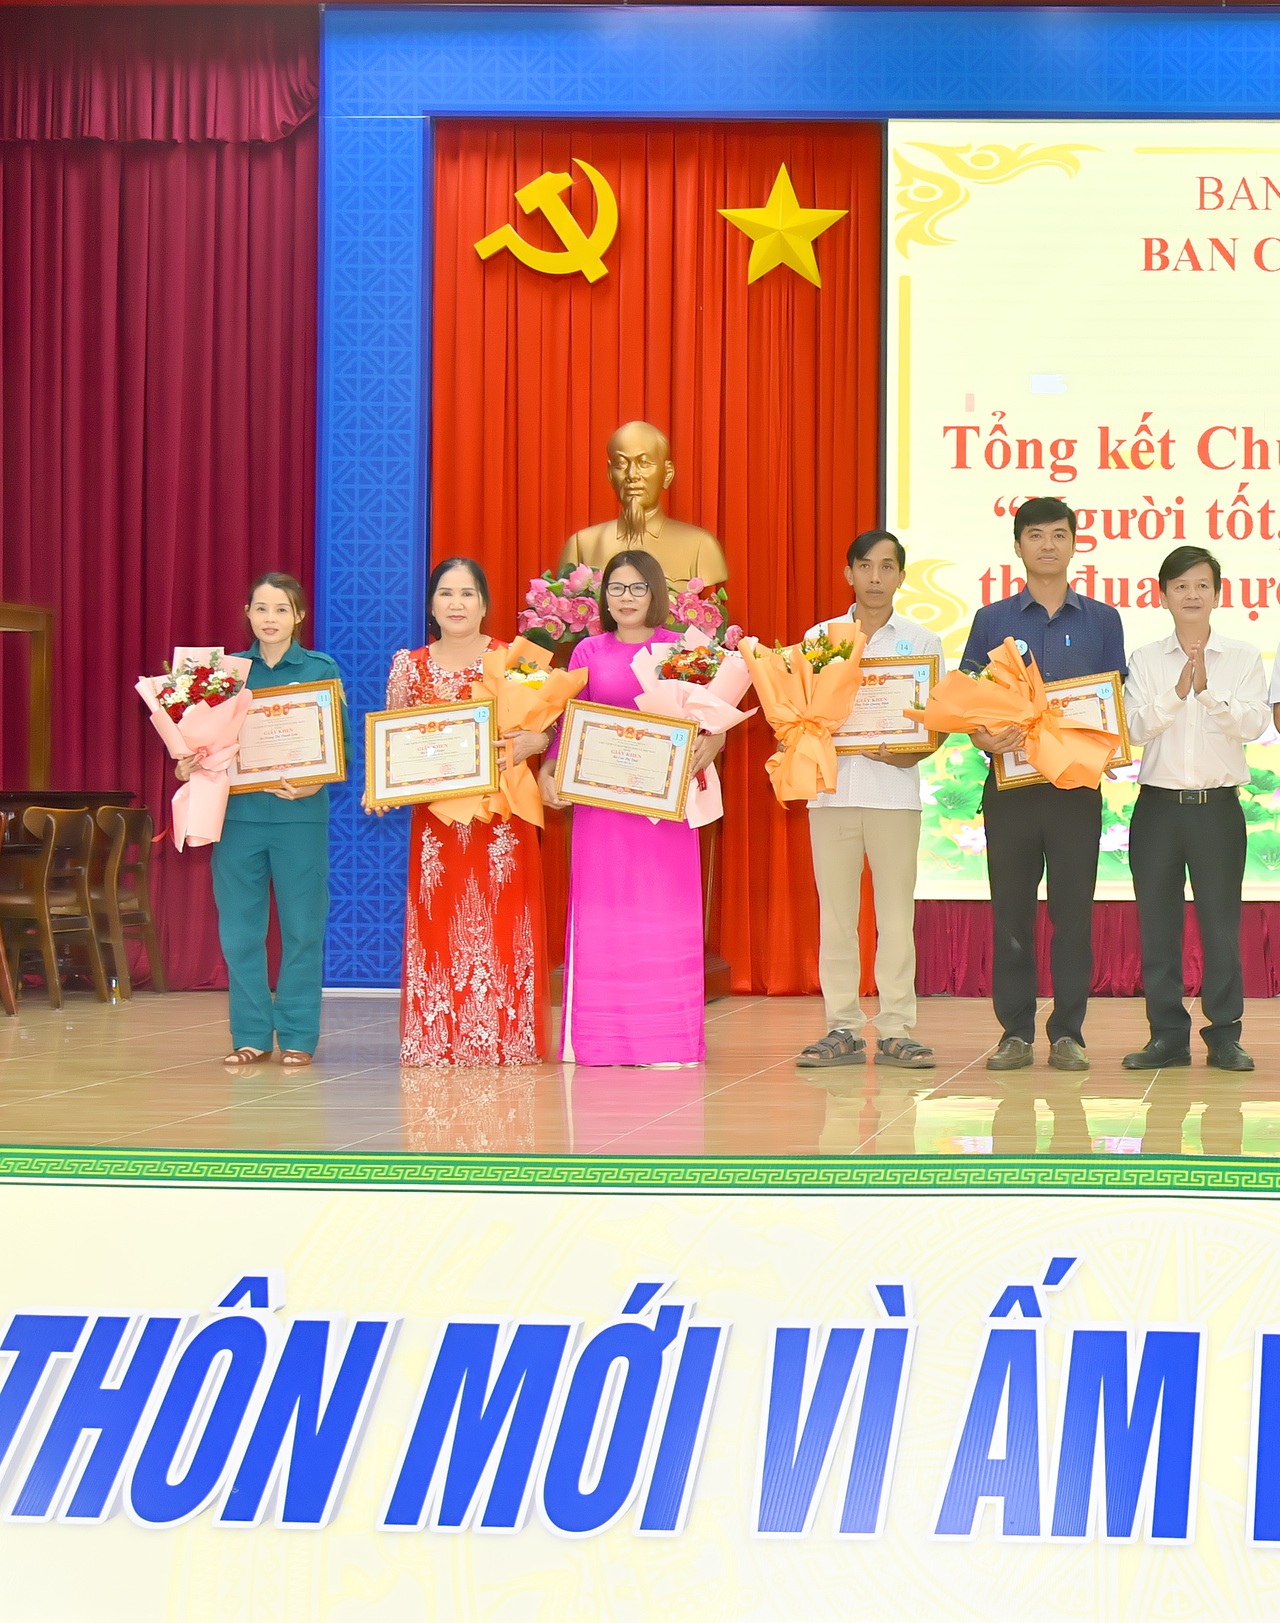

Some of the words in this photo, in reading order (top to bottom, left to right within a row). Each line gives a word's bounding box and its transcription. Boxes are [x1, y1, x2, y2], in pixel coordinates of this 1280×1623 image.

[1142, 237, 1239, 273] BAN
[942, 410, 1079, 483] Tổng
[1097, 411, 1177, 471] kết
[993, 495, 1187, 553] “gười
[917, 670, 926, 678] 14
[1100, 687, 1110, 695] 16
[320, 693, 328, 702] 11
[477, 710, 487, 718] 12
[674, 733, 685, 742] 13
[0, 1276, 389, 1524] THÔN
[383, 1282, 729, 1533] MỚI
[757, 1285, 909, 1535] VÌ
[935, 1257, 1202, 1540] ẤM
